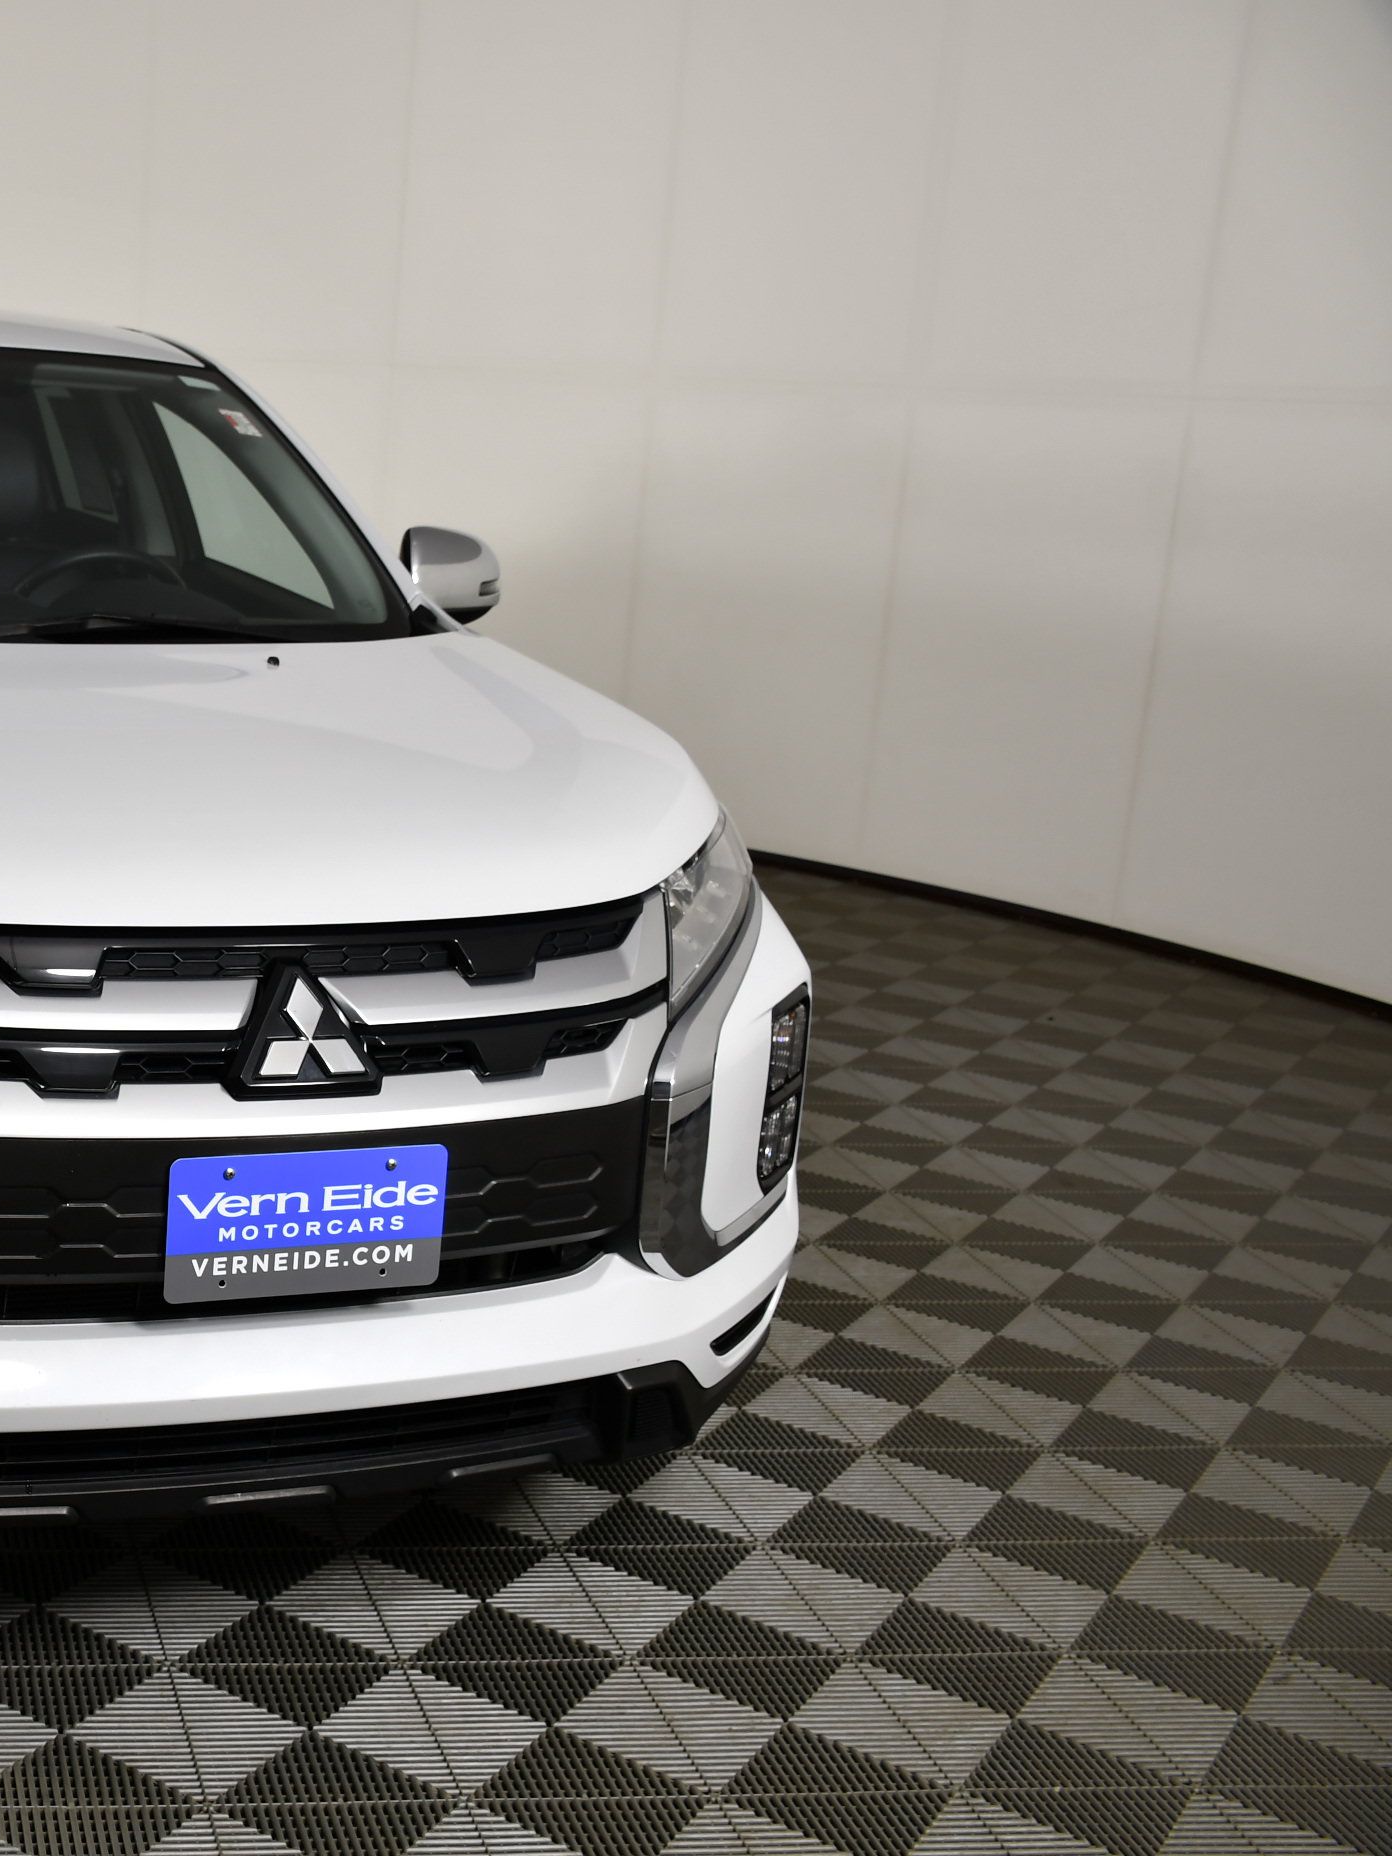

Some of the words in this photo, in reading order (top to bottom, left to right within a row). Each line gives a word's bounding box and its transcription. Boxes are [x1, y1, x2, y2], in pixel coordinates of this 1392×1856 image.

[176, 1191, 310, 1220] Vern
[321, 1180, 439, 1212] Eide
[218, 1215, 405, 1243] MOTORCARS
[191, 1243, 414, 1278] VERNEIDE.COM
